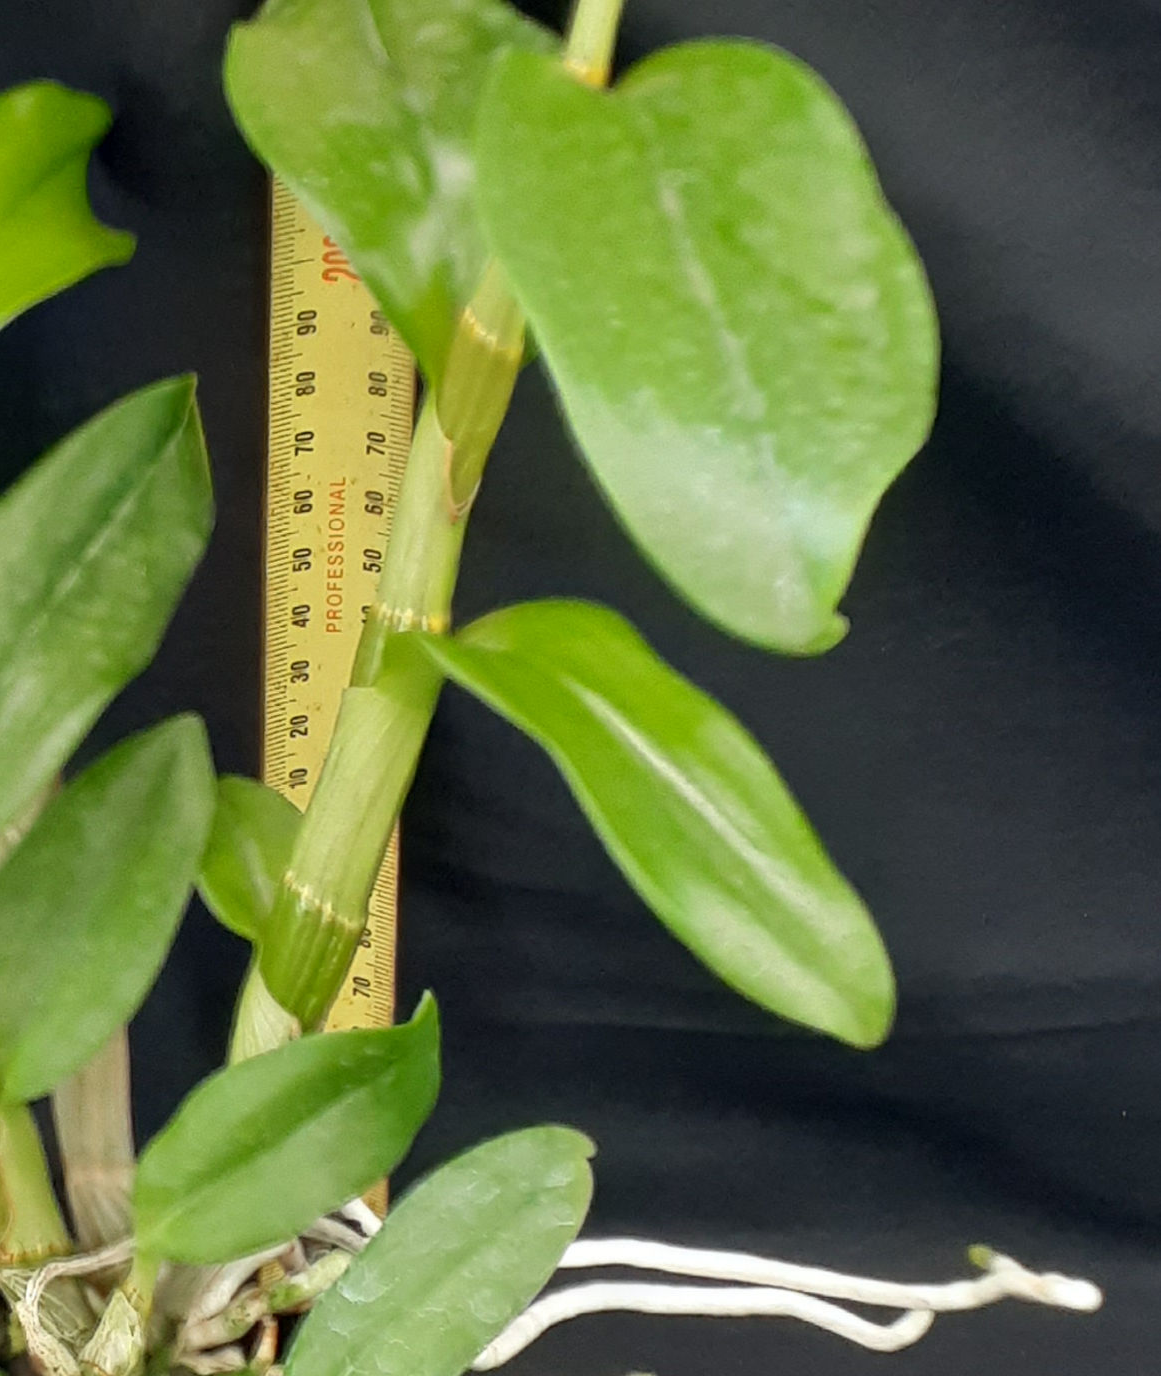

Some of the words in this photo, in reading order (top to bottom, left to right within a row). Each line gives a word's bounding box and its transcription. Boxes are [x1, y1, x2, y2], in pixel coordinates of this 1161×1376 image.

[296, 309, 318, 336] 90
[295, 371, 316, 397] 80
[367, 371, 388, 398] 80
[294, 430, 315, 457] 70
[366, 431, 386, 456] 70
[293, 489, 314, 515] 60
[364, 490, 385, 516] 60
[292, 547, 312, 573] 50
[325, 477, 347, 634] PROFESSIONAL
[362, 548, 382, 573] 50
[290, 604, 311, 628] 40
[290, 660, 310, 684] 30
[288, 714, 309, 739] 20
[288, 768, 308, 790] 10
[352, 976, 371, 998] 70
